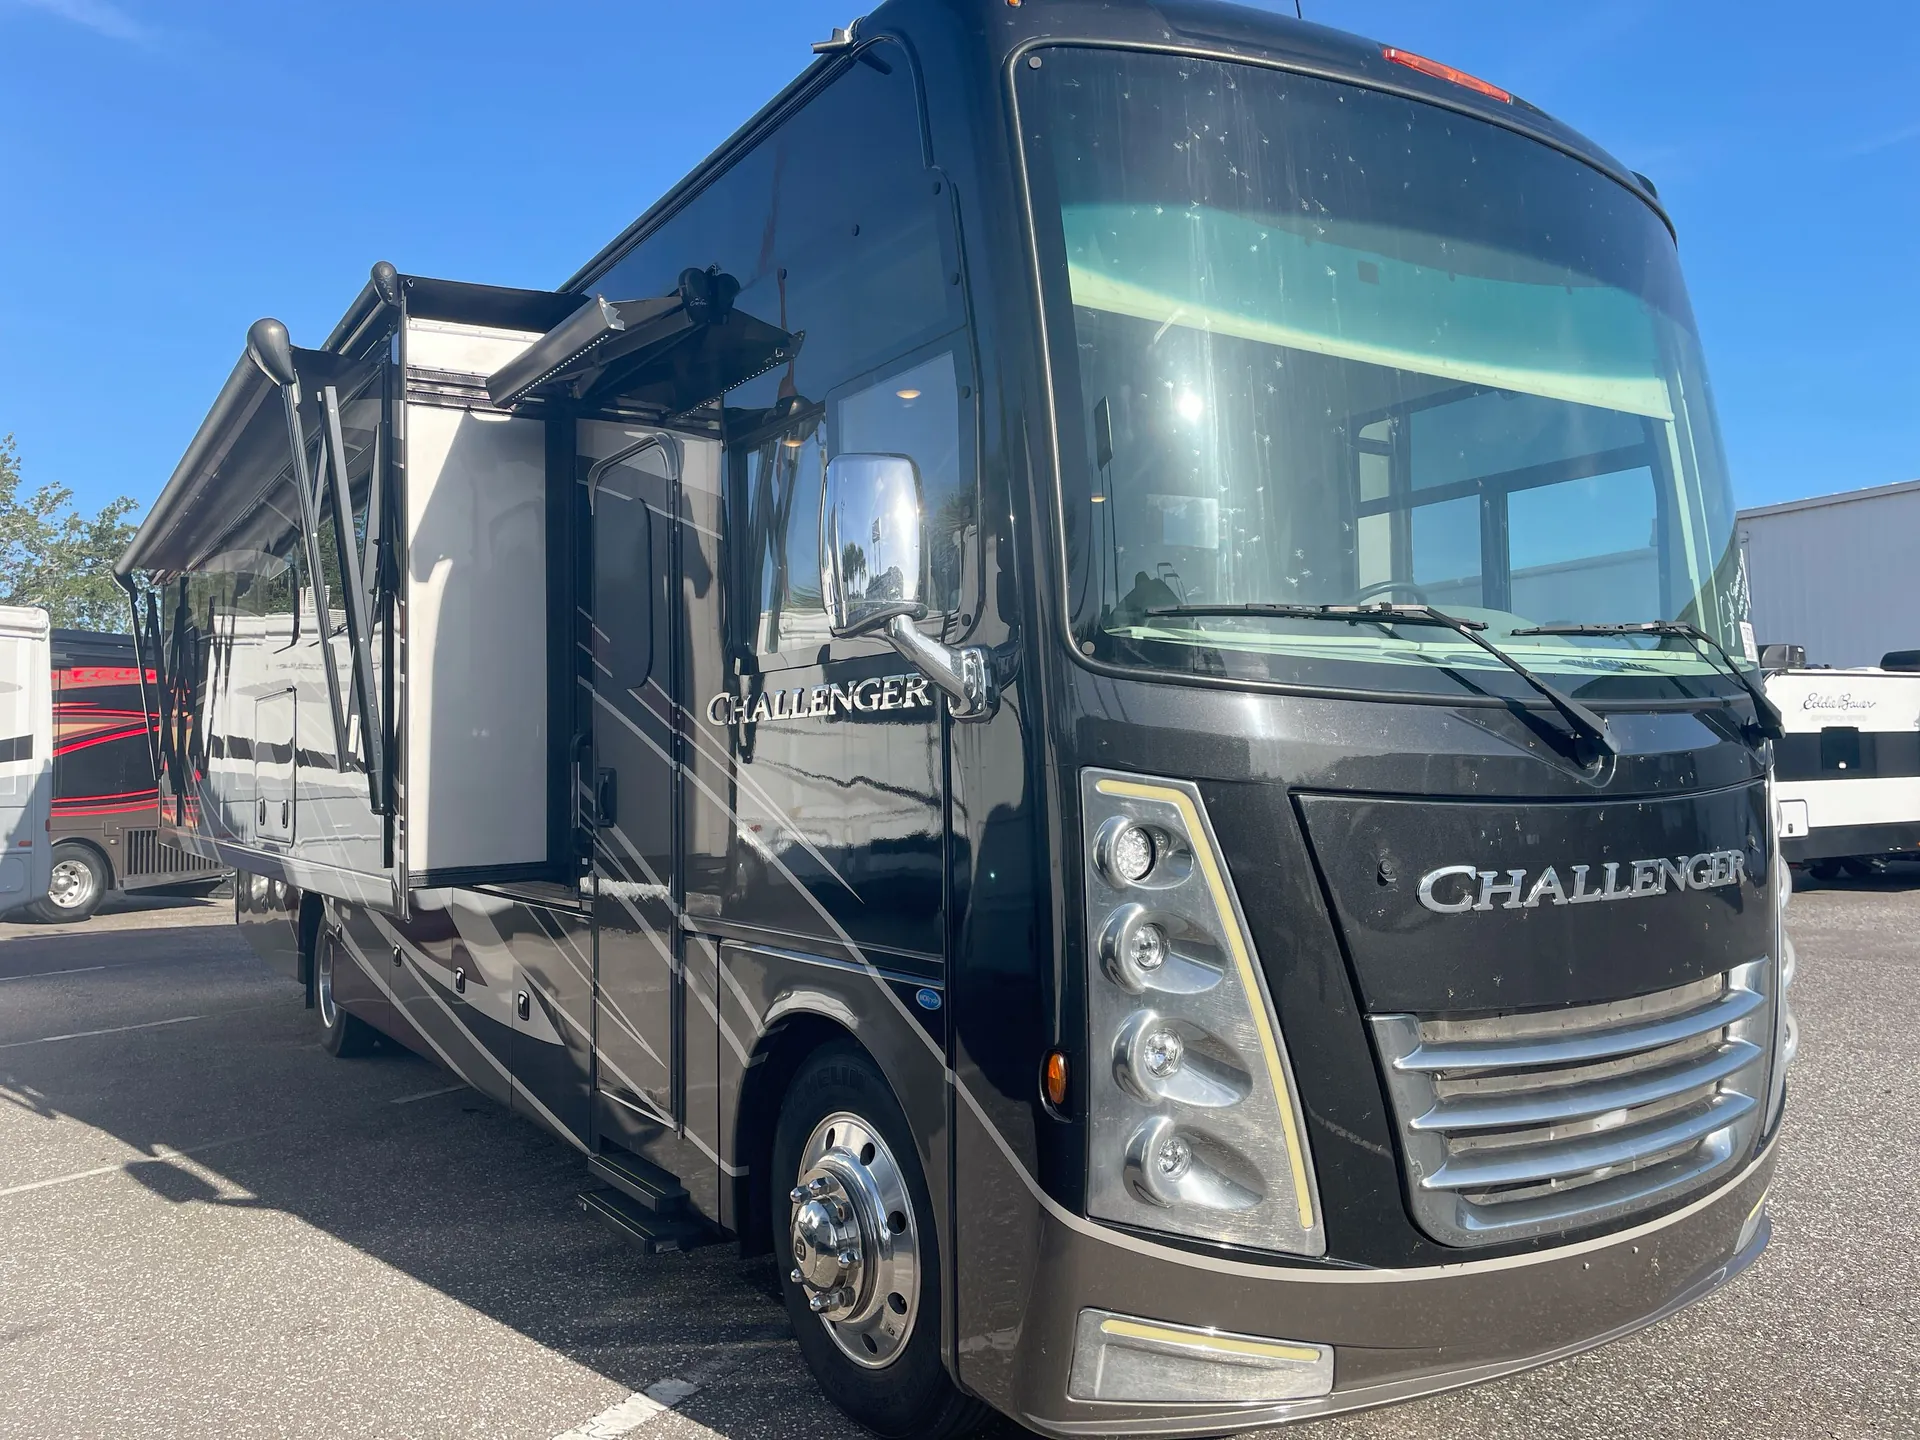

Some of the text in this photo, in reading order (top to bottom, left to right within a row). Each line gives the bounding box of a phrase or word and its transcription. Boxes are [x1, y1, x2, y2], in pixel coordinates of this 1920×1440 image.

[706, 673, 933, 726] CHALLENGER
[1799, 692, 1877, 711] Eddie Bauer
[1415, 849, 1747, 914] CHALLENGER
